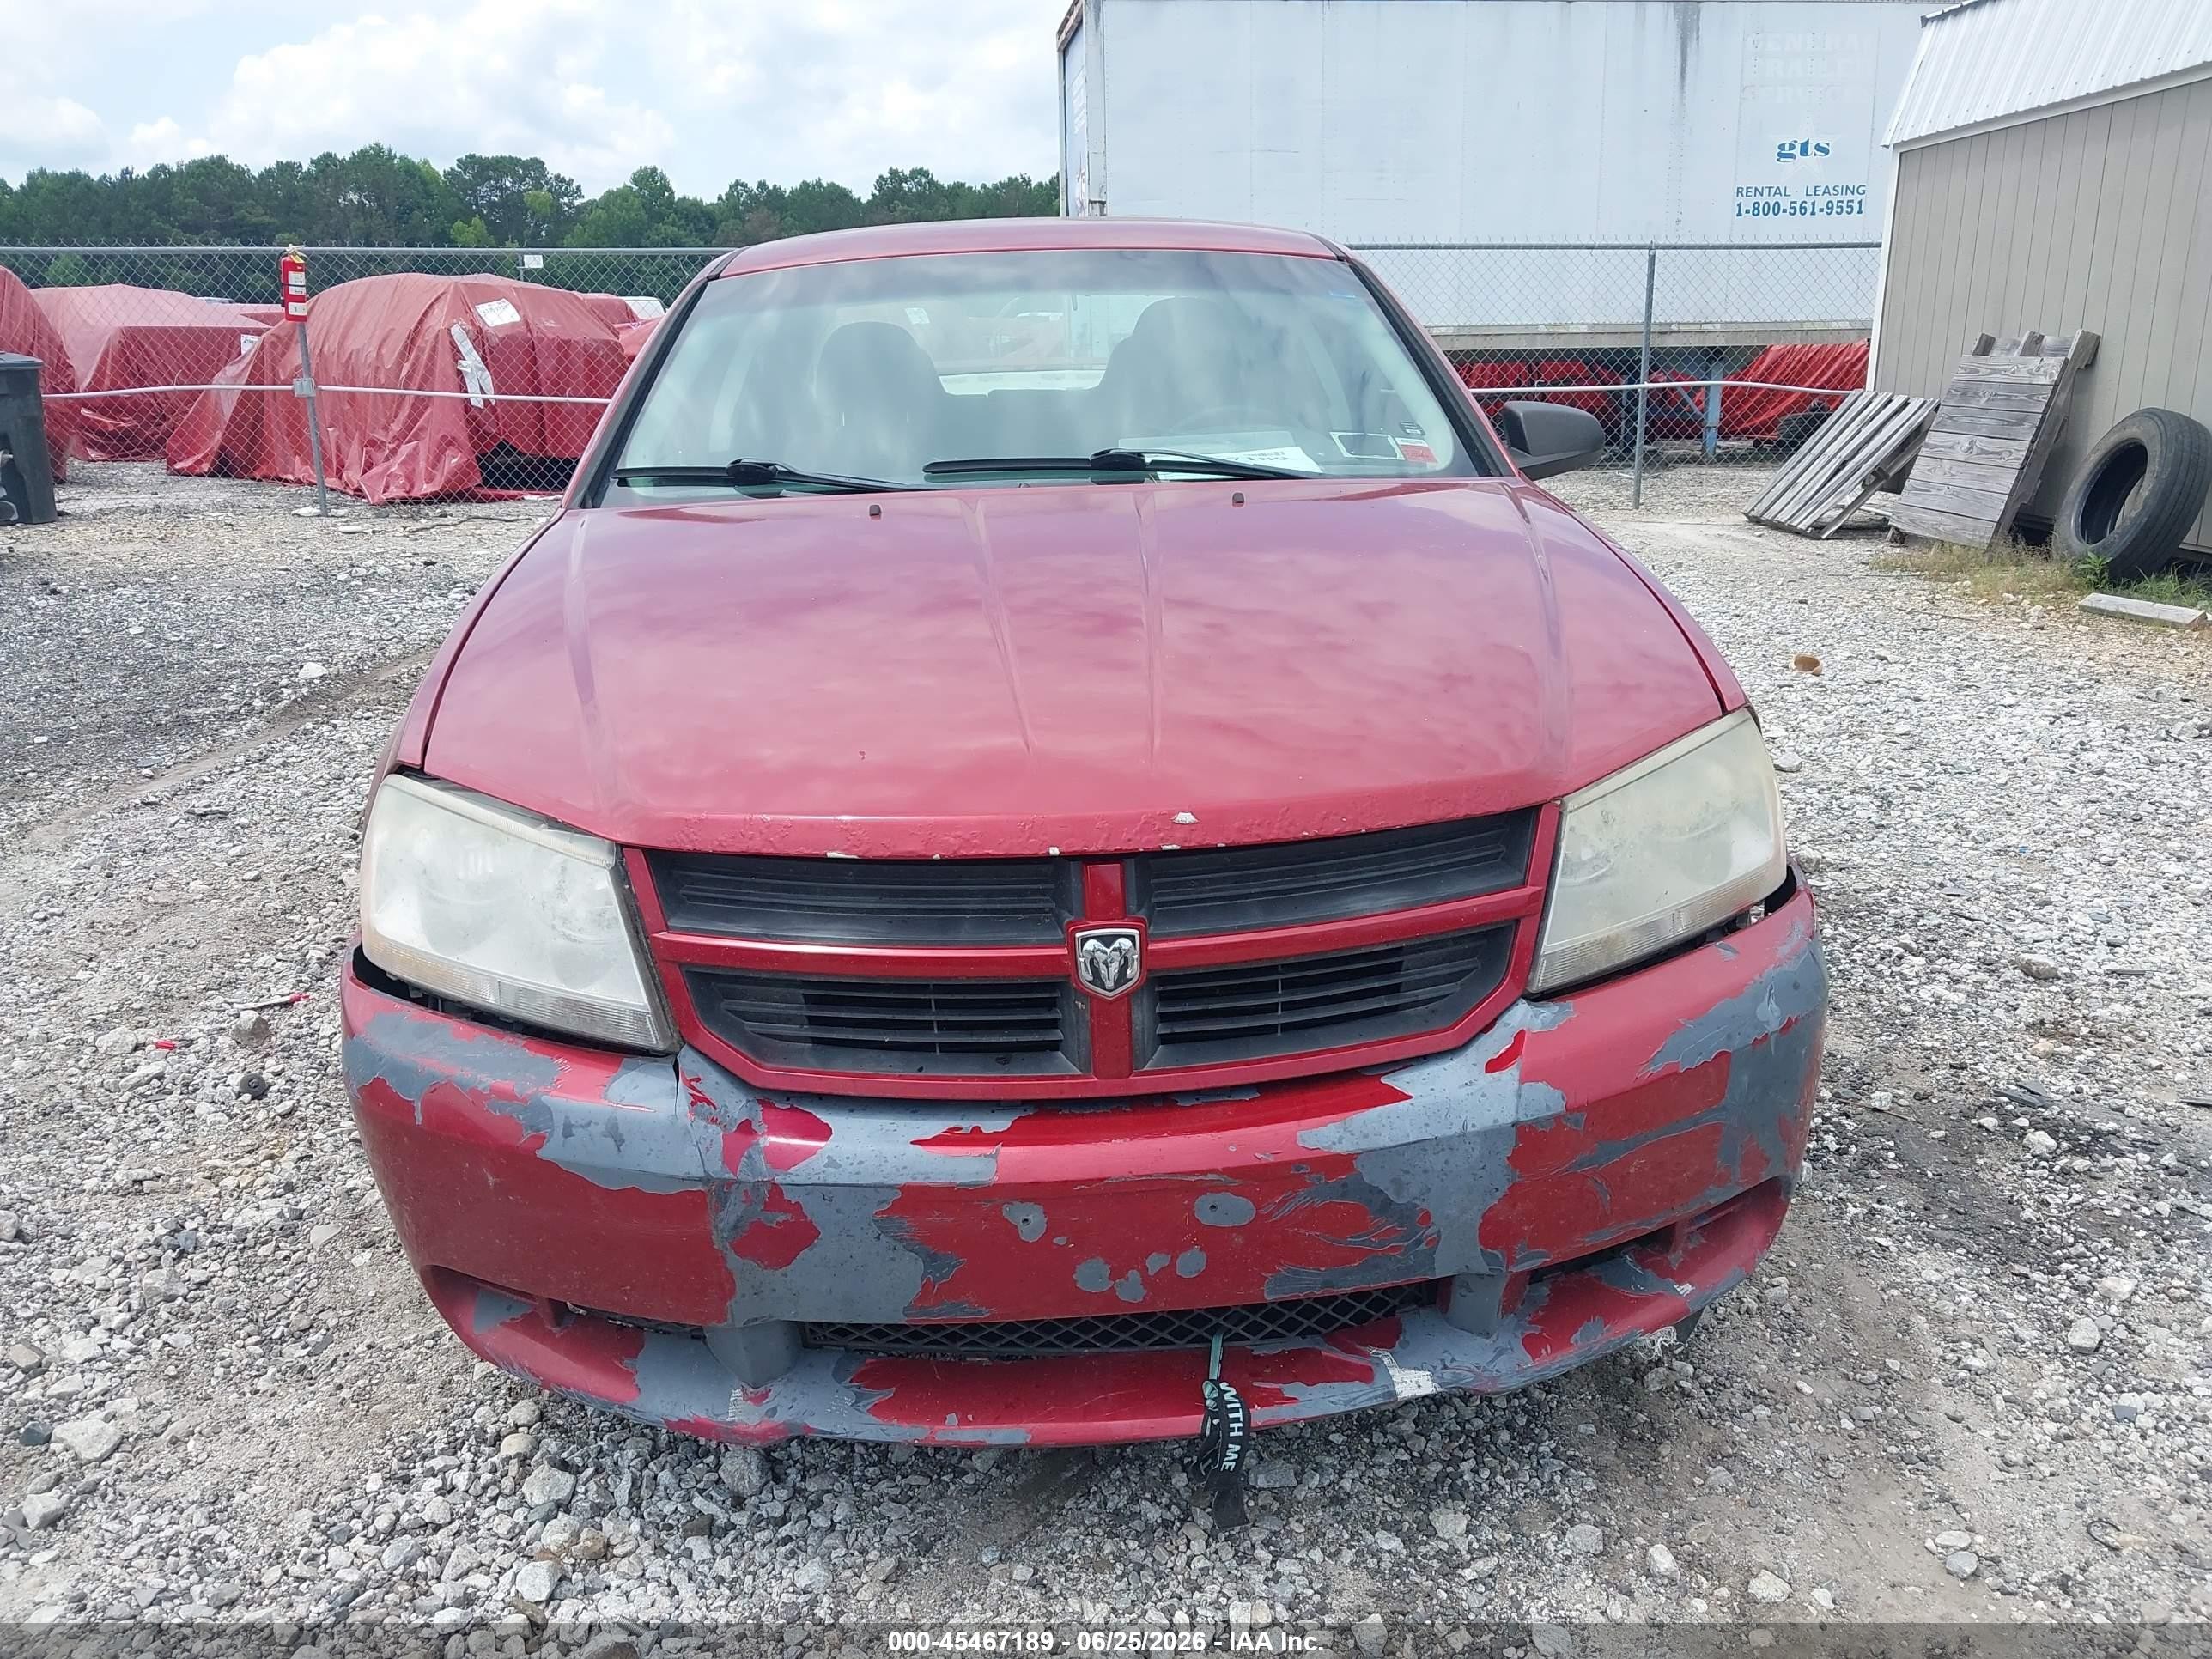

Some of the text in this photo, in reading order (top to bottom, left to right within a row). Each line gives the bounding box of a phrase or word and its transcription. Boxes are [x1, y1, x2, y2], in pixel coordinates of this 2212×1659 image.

[1776, 137, 1832, 163] gts
[1735, 184, 1867, 198] RENTAL LEASING
[1735, 198, 1864, 217] 1-800-561-9551
[1219, 1381, 1244, 1472] WITH ME
